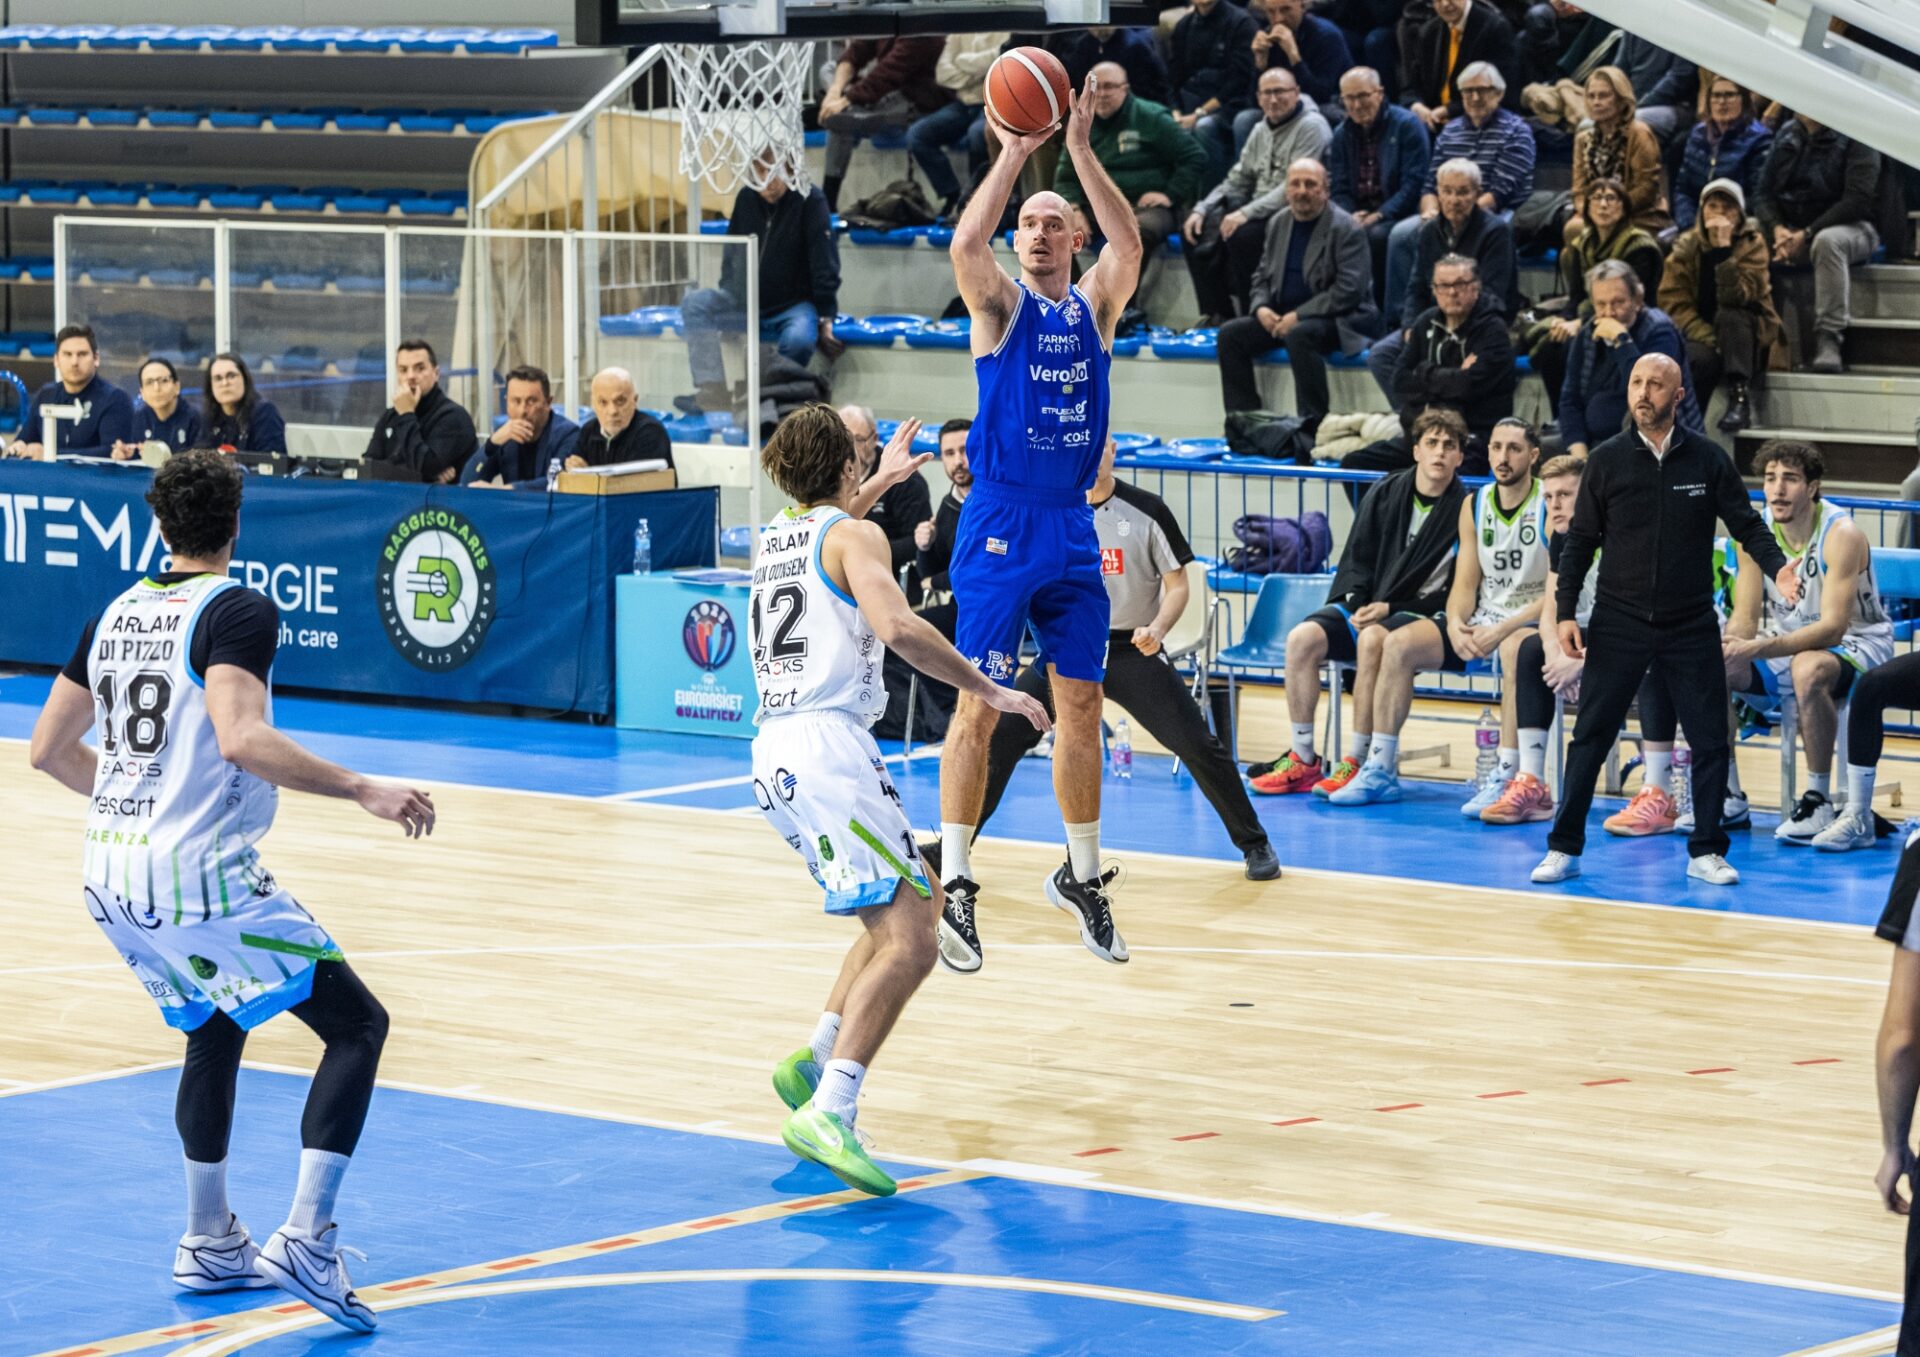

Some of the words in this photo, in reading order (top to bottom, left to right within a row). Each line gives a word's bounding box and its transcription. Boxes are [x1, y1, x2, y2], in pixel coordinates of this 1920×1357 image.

[384, 510, 488, 571] RAGGISOLARIS
[1493, 549, 1523, 571] 58
[299, 628, 338, 649] care
[97, 639, 116, 661] DI
[121, 639, 175, 662] PIZZO
[674, 689, 744, 711] EUROBASKET
[95, 669, 176, 757] 18
[675, 705, 743, 723] QUALIFIERS
[94, 794, 156, 818] resart
